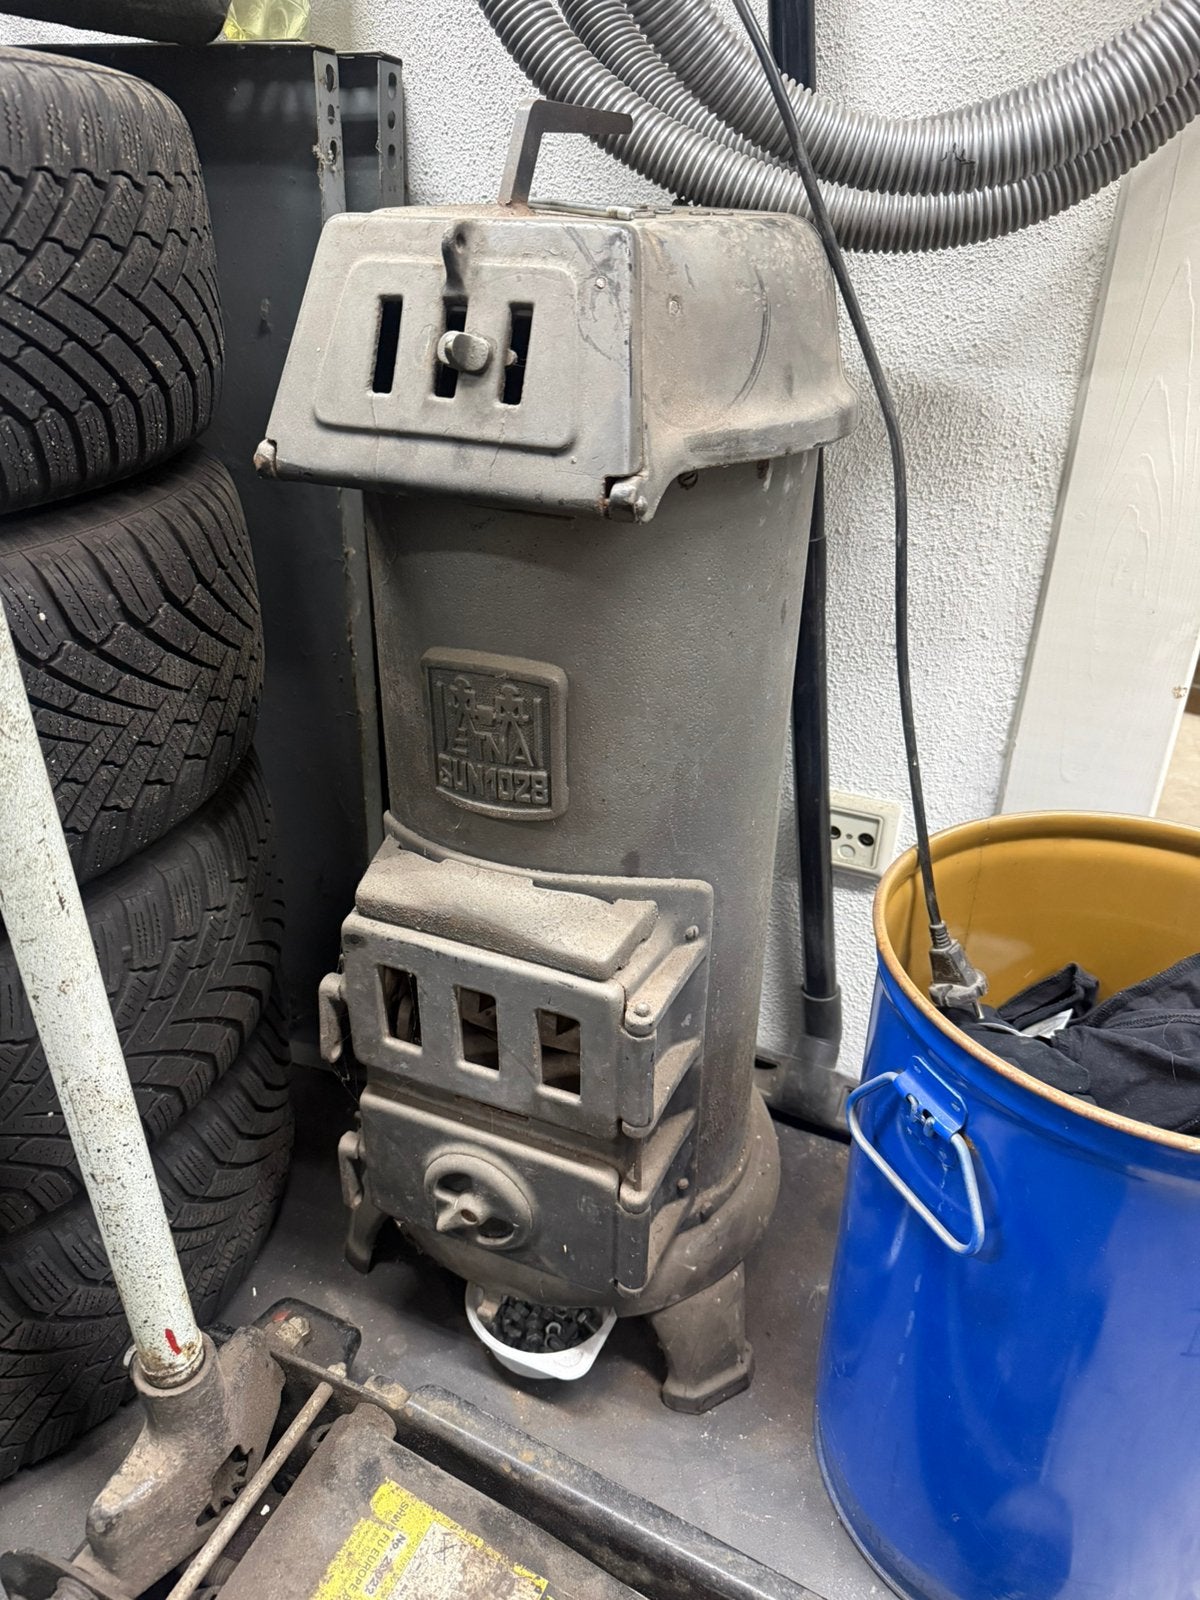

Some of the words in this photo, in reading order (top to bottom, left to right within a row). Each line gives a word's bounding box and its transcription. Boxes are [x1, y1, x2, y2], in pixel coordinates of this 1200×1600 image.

[377, 1532, 390, 1548] FU
[389, 1533, 406, 1551] No.
[349, 1548, 380, 1592] EUROPE
